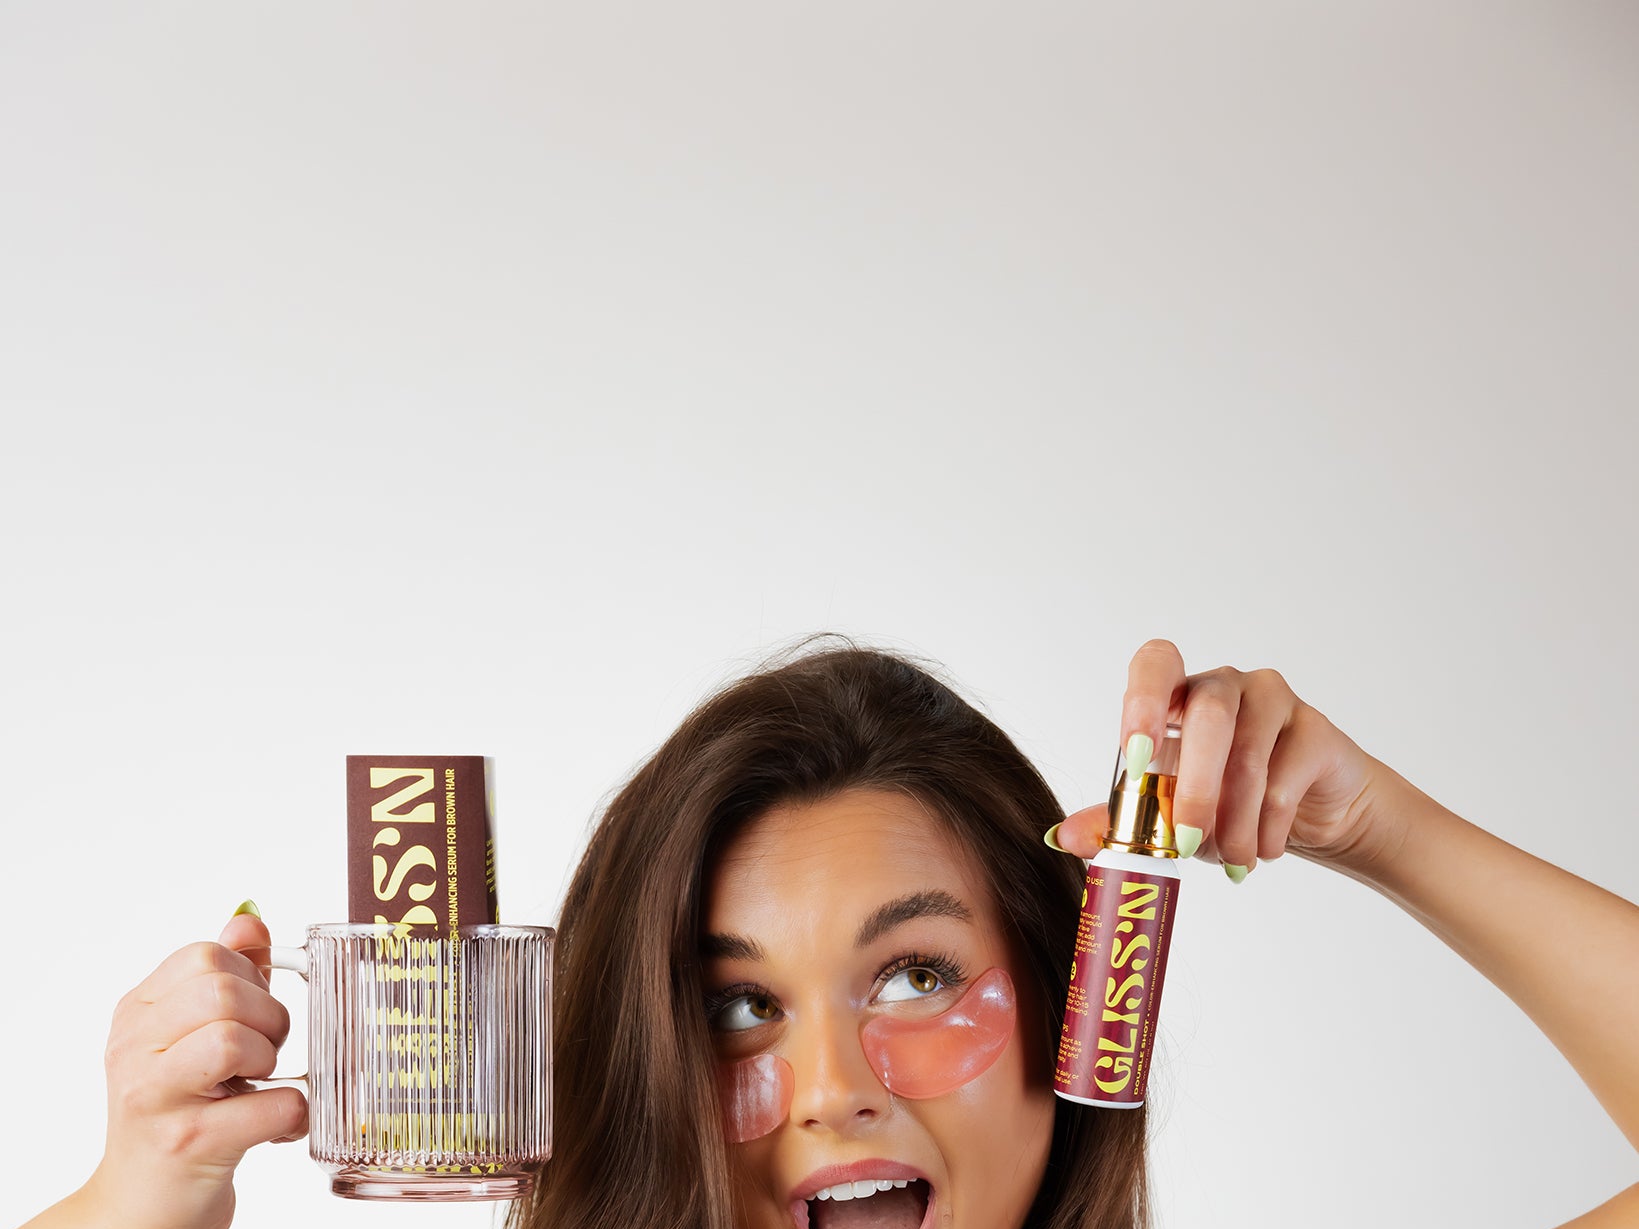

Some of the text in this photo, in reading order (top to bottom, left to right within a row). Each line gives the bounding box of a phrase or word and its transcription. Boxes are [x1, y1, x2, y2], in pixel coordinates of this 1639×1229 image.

[445, 768, 456, 790] HAIR
[446, 792, 457, 825] BROWN
[446, 828, 457, 845] FOR
[447, 846, 458, 876] SERUM
[1090, 877, 1104, 886] USE
[1094, 881, 1160, 1094] GLISS'N
[1133, 1051, 1145, 1095] DOUBLE
[1141, 1019, 1150, 1049] SHOT
